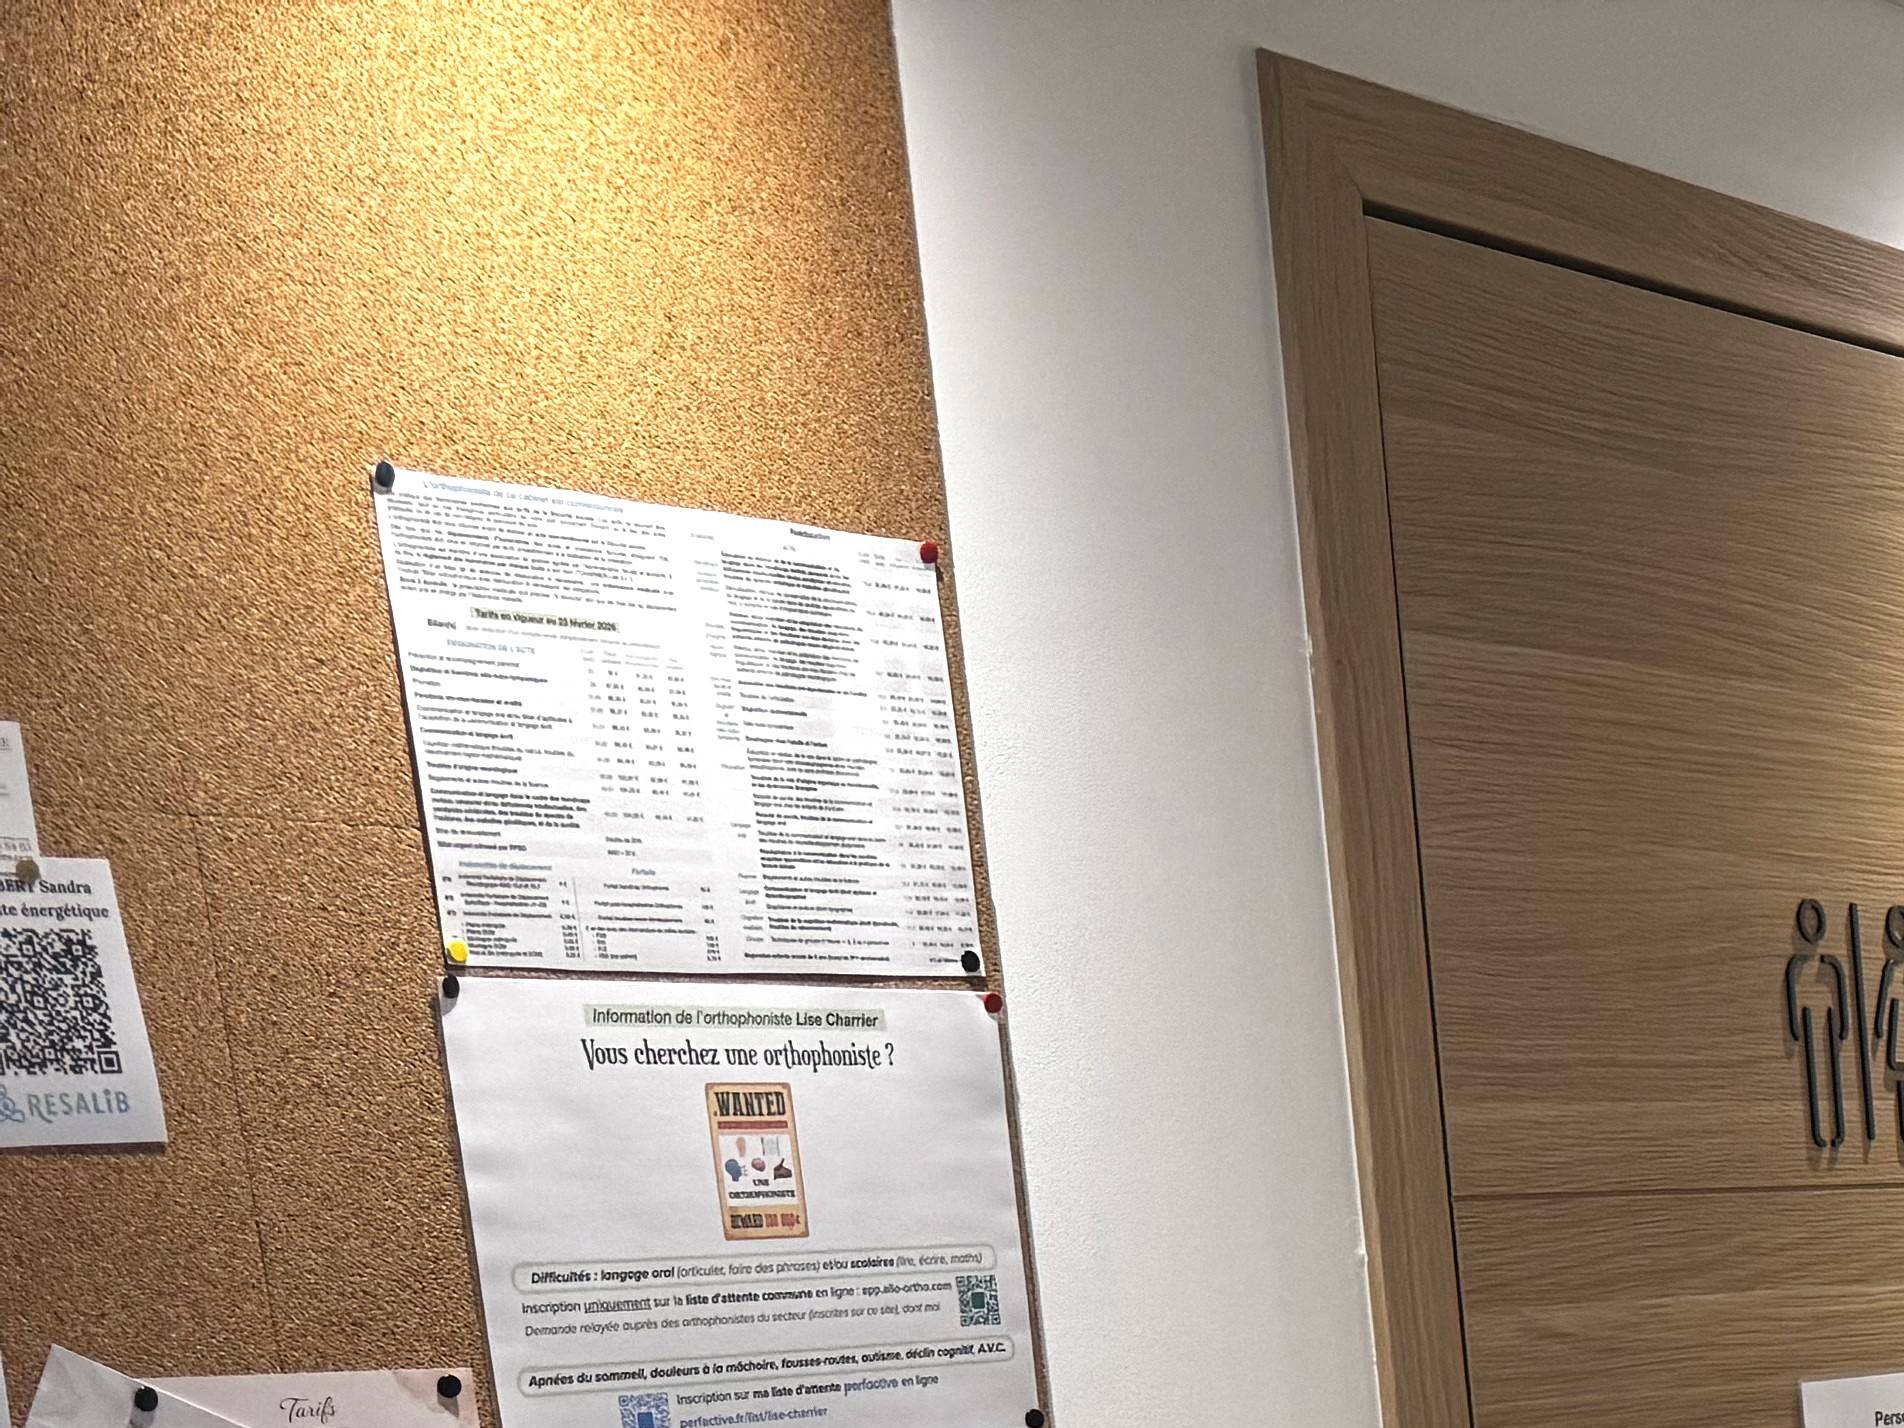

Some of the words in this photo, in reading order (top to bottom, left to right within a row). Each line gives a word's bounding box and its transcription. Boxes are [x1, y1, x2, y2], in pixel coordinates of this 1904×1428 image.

[474, 608, 499, 620] Tarifs
[500, 613, 512, 621] en
[39, 880, 92, 894] Sandra
[21, 903, 110, 921] énergétique
[592, 1007, 671, 1024] Information
[675, 1009, 692, 1024] de
[696, 1009, 792, 1028] l'orthophoniste
[795, 1011, 822, 1026] Lise
[825, 1009, 878, 1027] Charrier
[580, 1038, 628, 1070] Vous
[634, 1038, 720, 1065] cherchez
[724, 1048, 758, 1065] une
[763, 1039, 881, 1073] orthophoniste
[884, 1042, 893, 1065] ?
[531, 1269, 591, 1284] Difficultés
[600, 1269, 649, 1282] langage
[650, 1265, 674, 1278] oral
[850, 1255, 894, 1268] scolaires
[528, 1372, 574, 1389] Apnées
[576, 1372, 592, 1383] du
[649, 1365, 700, 1378] douleurs
[701, 1363, 710, 1374] à
[712, 1362, 723, 1374] la
[279, 1396, 337, 1424] Tarifs
